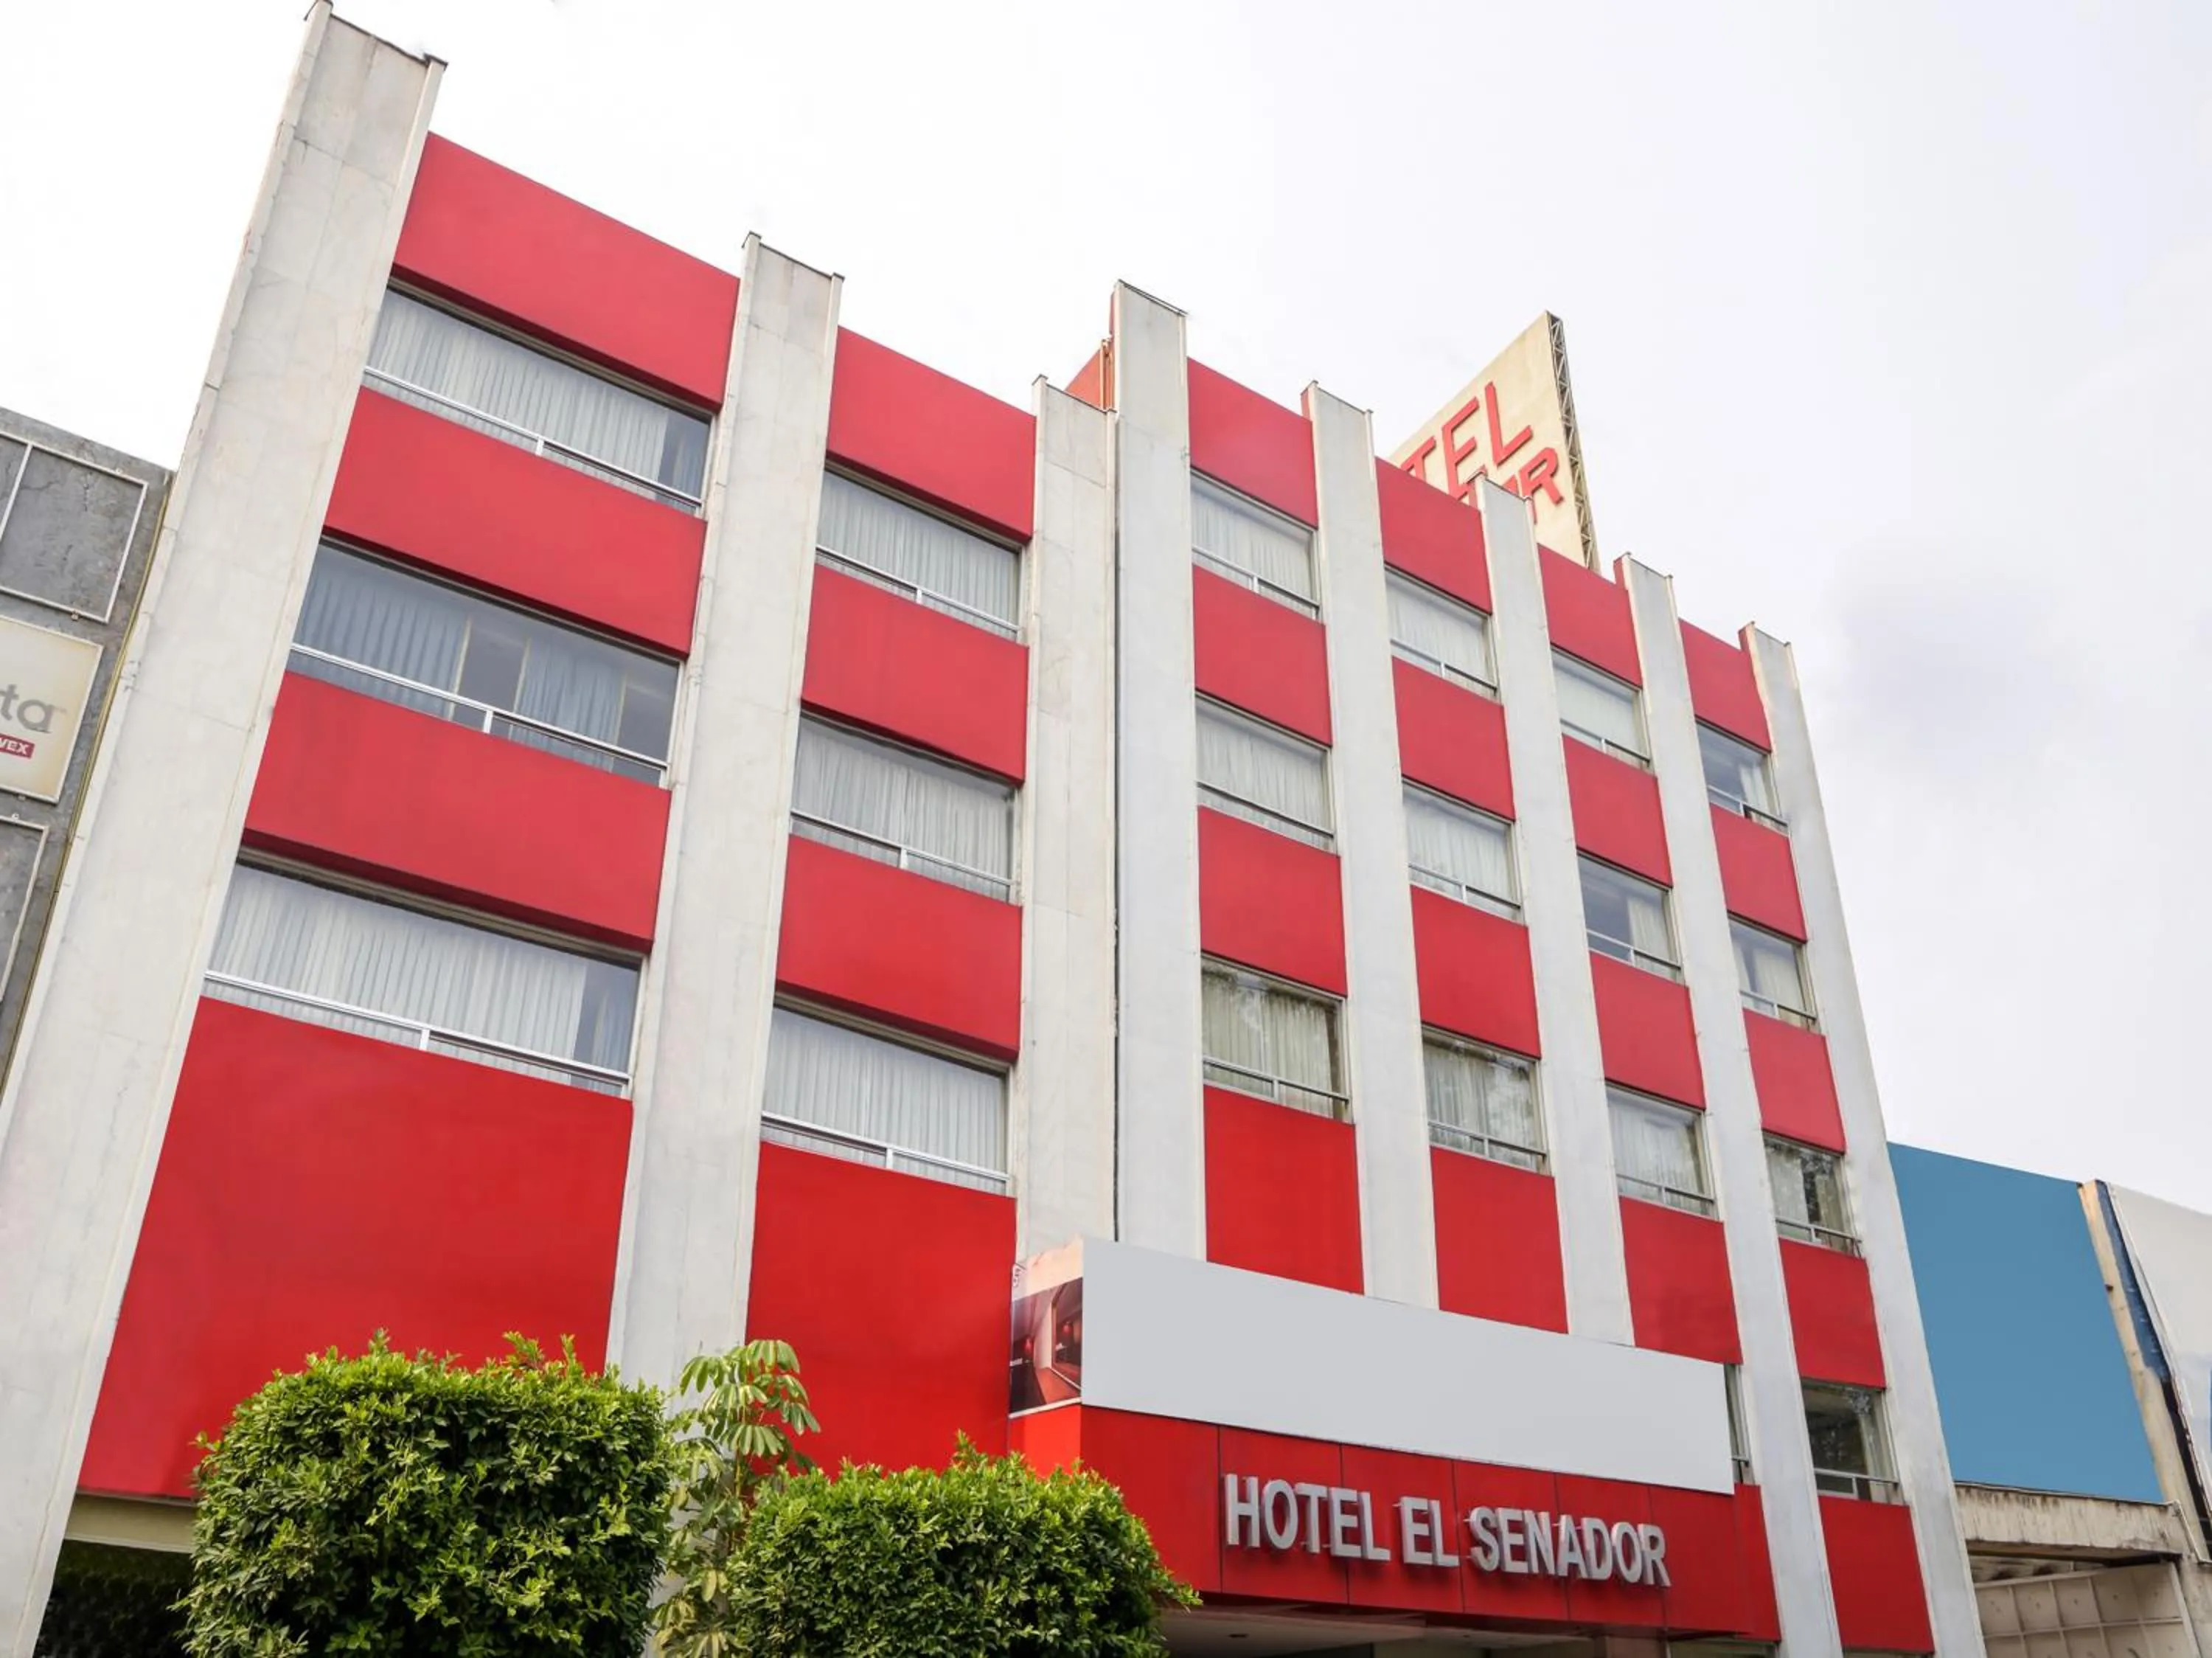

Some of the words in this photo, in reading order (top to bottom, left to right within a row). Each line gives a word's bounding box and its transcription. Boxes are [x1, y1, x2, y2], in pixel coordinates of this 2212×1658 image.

[1224, 1474, 1391, 1561] HOTEL
[1400, 1496, 1459, 1567] EL
[1470, 1507, 1671, 1586] SENADOR
